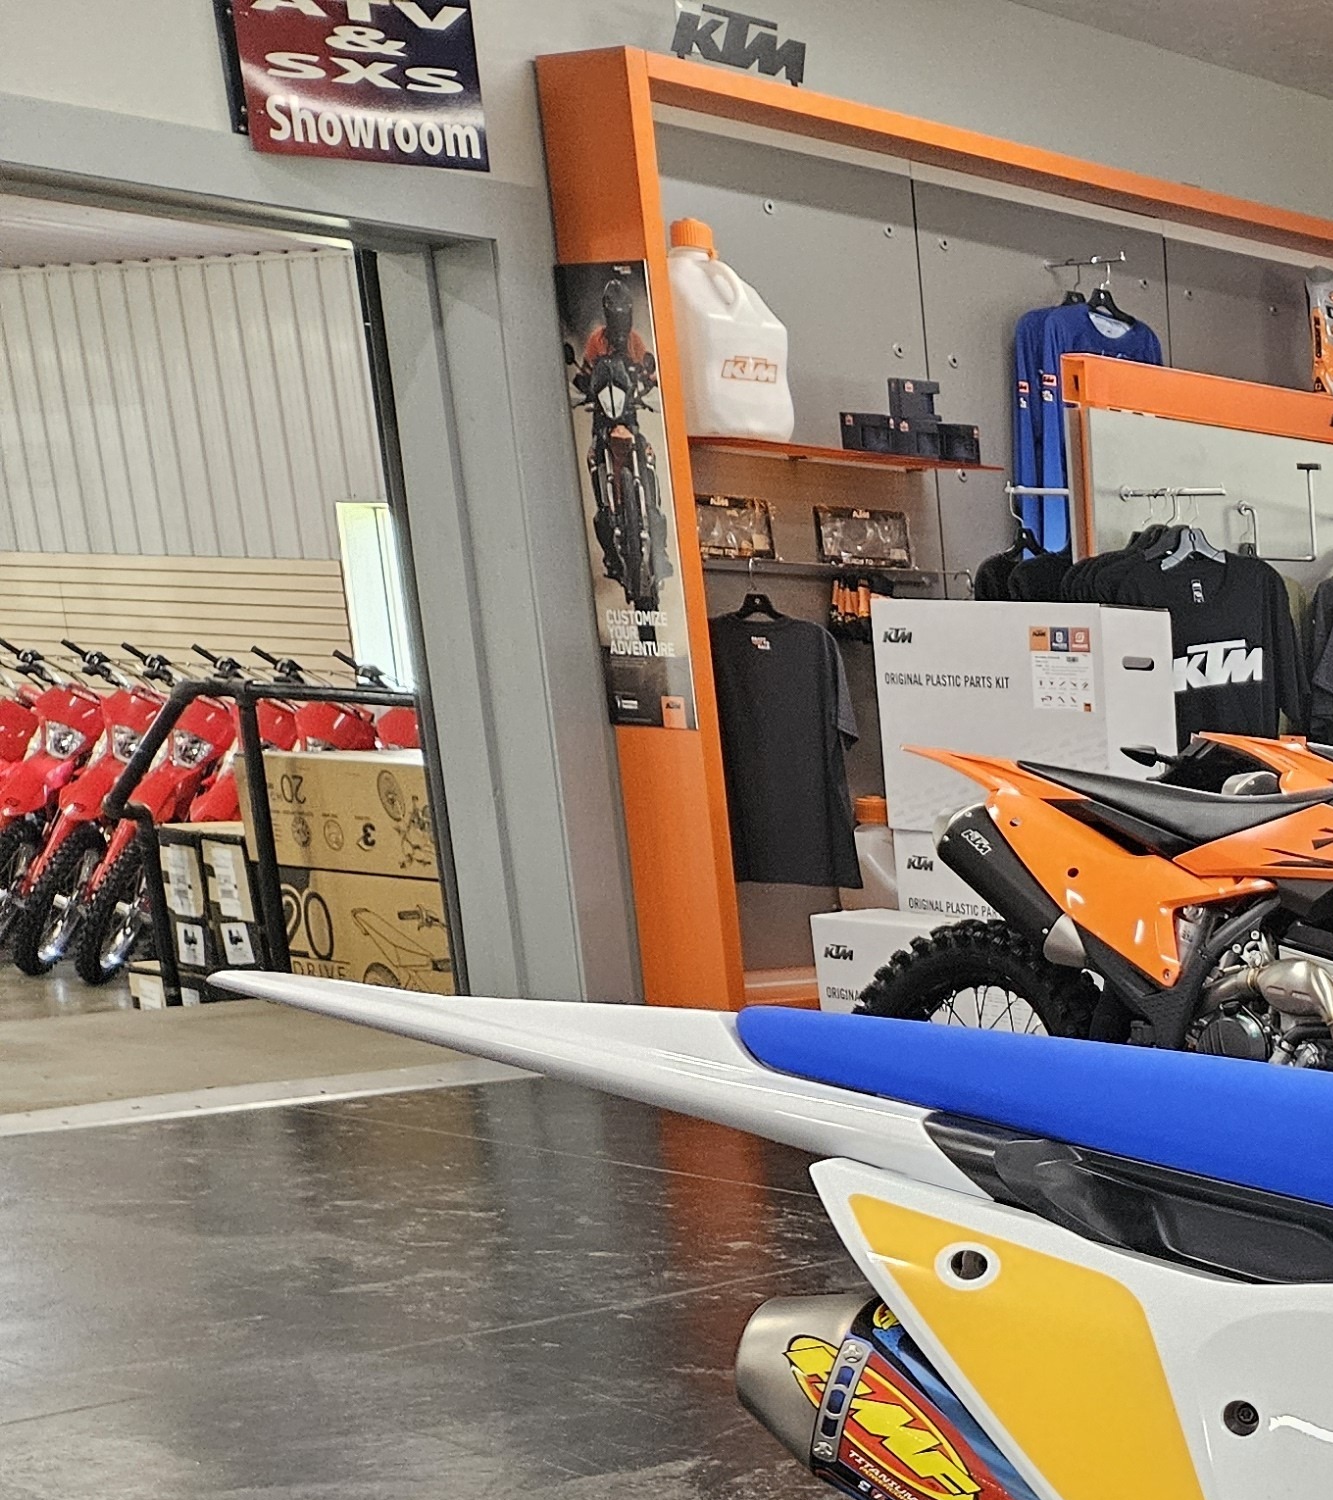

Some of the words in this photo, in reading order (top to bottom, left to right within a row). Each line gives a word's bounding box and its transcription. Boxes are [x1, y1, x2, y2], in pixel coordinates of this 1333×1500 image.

[325, 25, 407, 57] &
[671, 4, 806, 84] KTM
[265, 52, 464, 94] SXS
[266, 95, 481, 160] Showroom
[721, 356, 778, 384] KTM
[606, 609, 668, 626] CUSTOMIZE
[607, 625, 638, 640] YOUR
[882, 627, 913, 643] KTM
[609, 640, 676, 658] ADVENTURE
[1173, 639, 1263, 692] KTM
[884, 672, 924, 687] ORIGINAL
[926, 673, 961, 688] PLASTIC
[963, 675, 993, 689] PARTS
[995, 676, 1010, 689] KIT
[961, 829, 992, 856] KTM
[907, 855, 934, 872] KTM
[908, 897, 944, 913] ORIGINAL
[946, 901, 979, 917] PLASTIC
[981, 906, 998, 918] PAR
[824, 944, 854, 961] KTM
[293, 961, 348, 978] DRIVE
[826, 987, 860, 1001] ORIGINA
[782, 1345, 983, 1497] FMF
